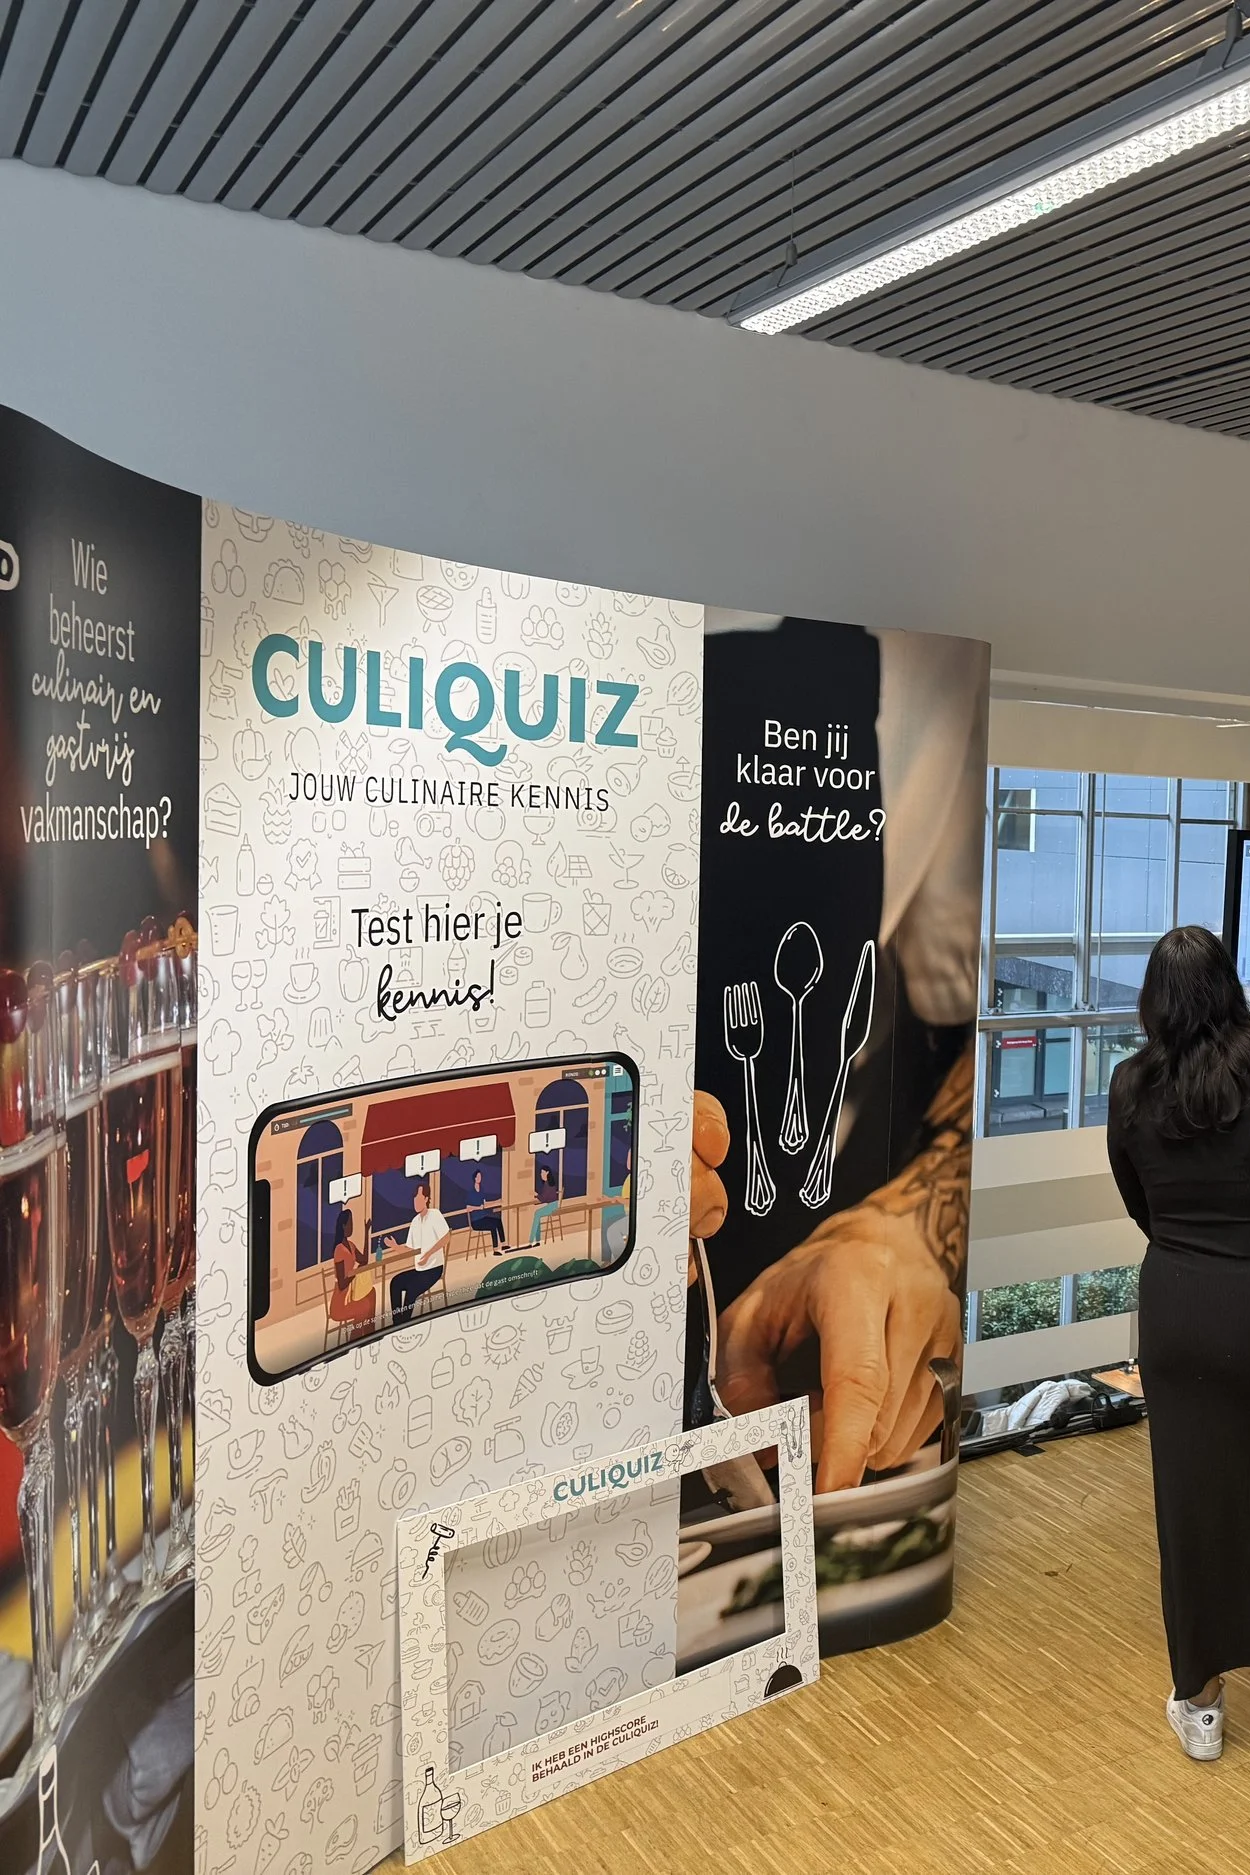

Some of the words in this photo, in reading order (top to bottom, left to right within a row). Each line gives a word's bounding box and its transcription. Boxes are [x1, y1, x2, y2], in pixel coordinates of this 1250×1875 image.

[71, 538, 108, 595] Wie
[50, 593, 135, 663] beheerst
[32, 648, 123, 724] culinair
[130, 685, 161, 715] en
[251, 633, 640, 767] CULIQUIZ
[46, 709, 135, 787] gastvrij
[764, 719, 817, 750] Ben
[824, 723, 848, 760] jij
[288, 773, 356, 802] JOUW
[365, 776, 499, 807] CULINAIRE
[511, 784, 609, 812] KENNIS
[737, 753, 807, 786] klaar
[814, 767, 876, 790] voor
[20, 792, 172, 849] vakmanschap?
[720, 801, 759, 837] de
[768, 802, 887, 843] battle?
[351, 908, 413, 947] Test
[424, 903, 485, 942] hier
[493, 901, 522, 949] je
[377, 959, 495, 1021] kennis!
[553, 1451, 662, 1501] CULIQUIZ
[532, 1761, 542, 1772] IK
[544, 1750, 566, 1767] HEB
[568, 1741, 588, 1756] EEN
[590, 1715, 647, 1747] HIGHSCORE
[532, 1755, 581, 1782] BEHAALD
[583, 1748, 594, 1760] IN
[596, 1741, 610, 1754] DE
[612, 1719, 659, 1746] CULIQUIZ!
